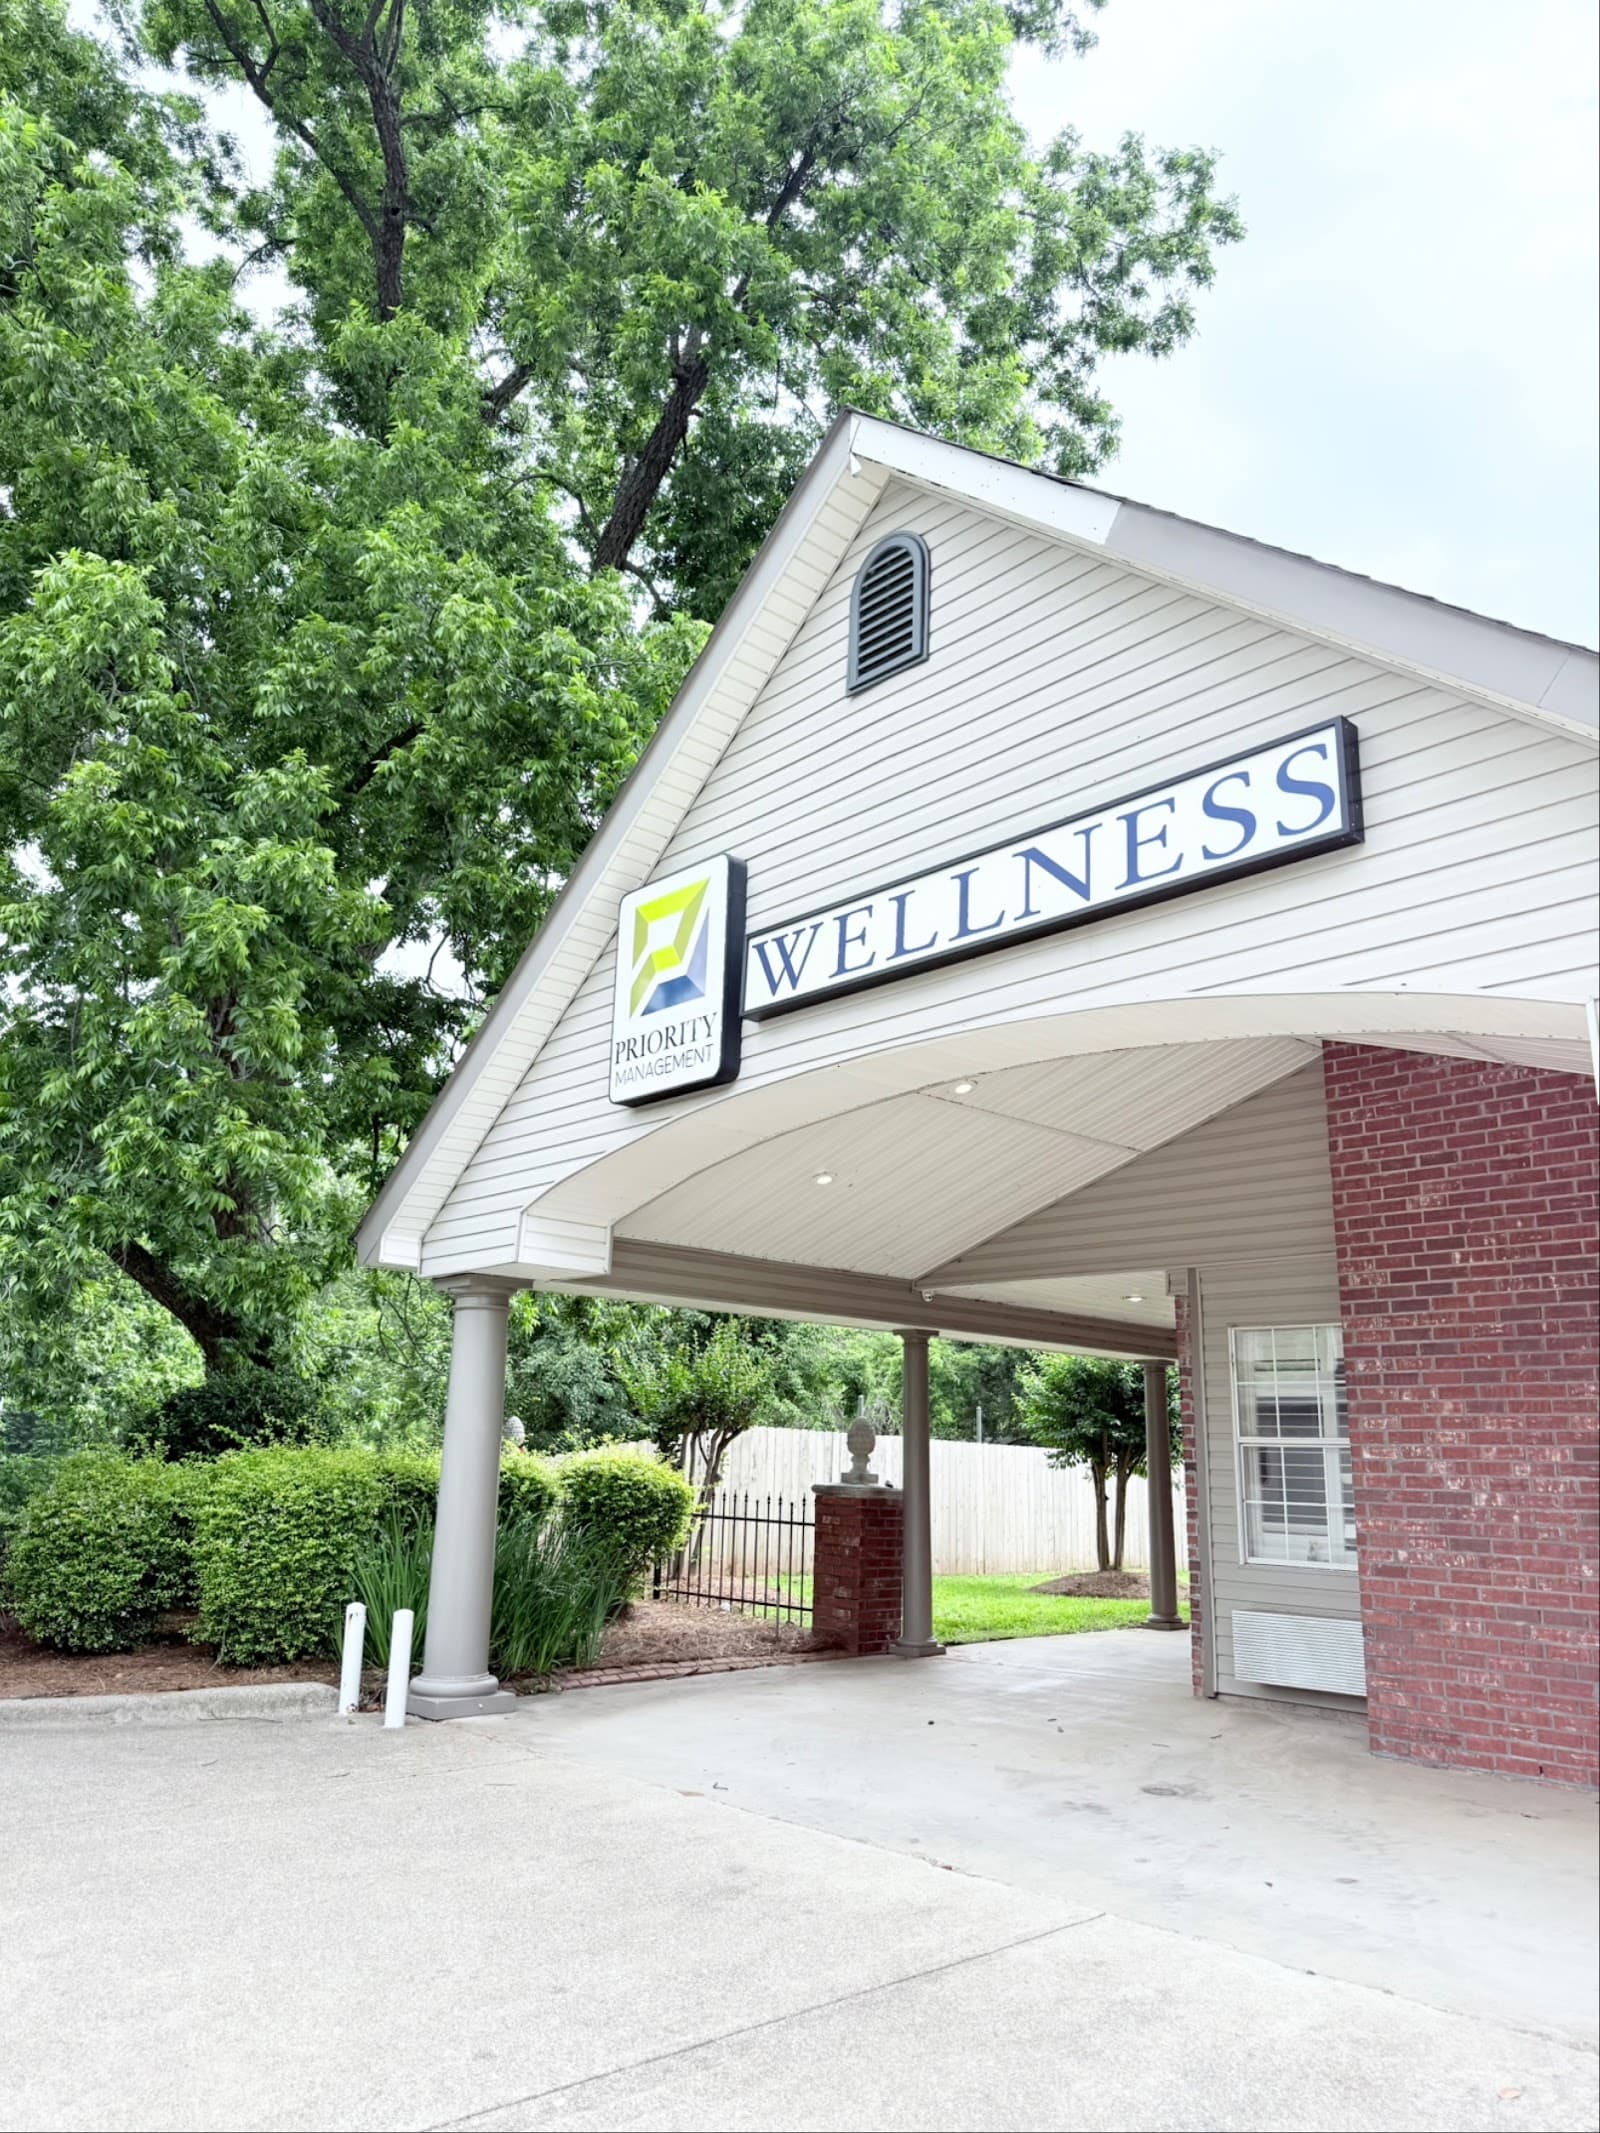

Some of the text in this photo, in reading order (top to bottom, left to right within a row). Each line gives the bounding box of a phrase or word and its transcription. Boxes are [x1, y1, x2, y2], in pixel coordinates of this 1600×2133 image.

[752, 742, 1336, 998] WELLNESS
[614, 1012, 717, 1065] PRIORITY
[614, 1043, 715, 1088] MANAGEMENT
